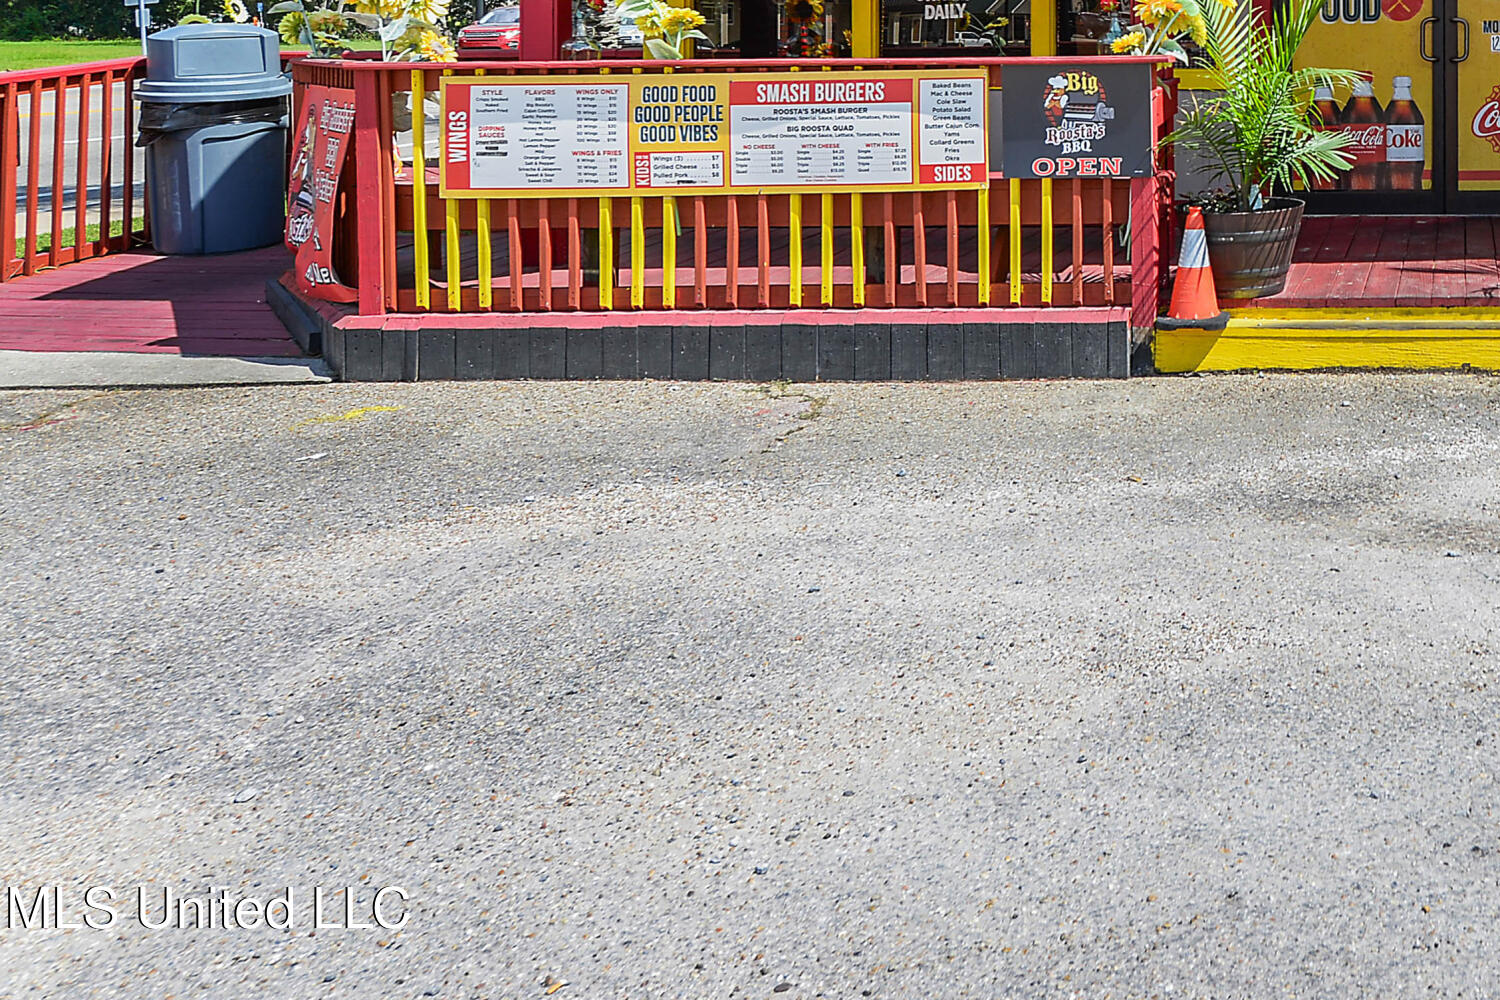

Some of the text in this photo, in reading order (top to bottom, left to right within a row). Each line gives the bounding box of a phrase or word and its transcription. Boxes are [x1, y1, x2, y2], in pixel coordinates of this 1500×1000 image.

[924, 3, 967, 20] DAILY
[756, 82, 885, 103] SMASH BURGERS
[1066, 71, 1099, 95] Big
[643, 85, 716, 103] GOOD FOOD
[634, 105, 724, 123] GOOD PEOPLE
[448, 111, 467, 163] WINGS
[640, 125, 718, 142] GOOD VIBES
[1045, 125, 1106, 145] Roosta's
[1386, 128, 1422, 148] Coke
[1061, 140, 1092, 154] BBQ
[636, 155, 649, 186] KIDS!
[934, 165, 972, 182] SIDES
[1032, 157, 1122, 176] OPEN
